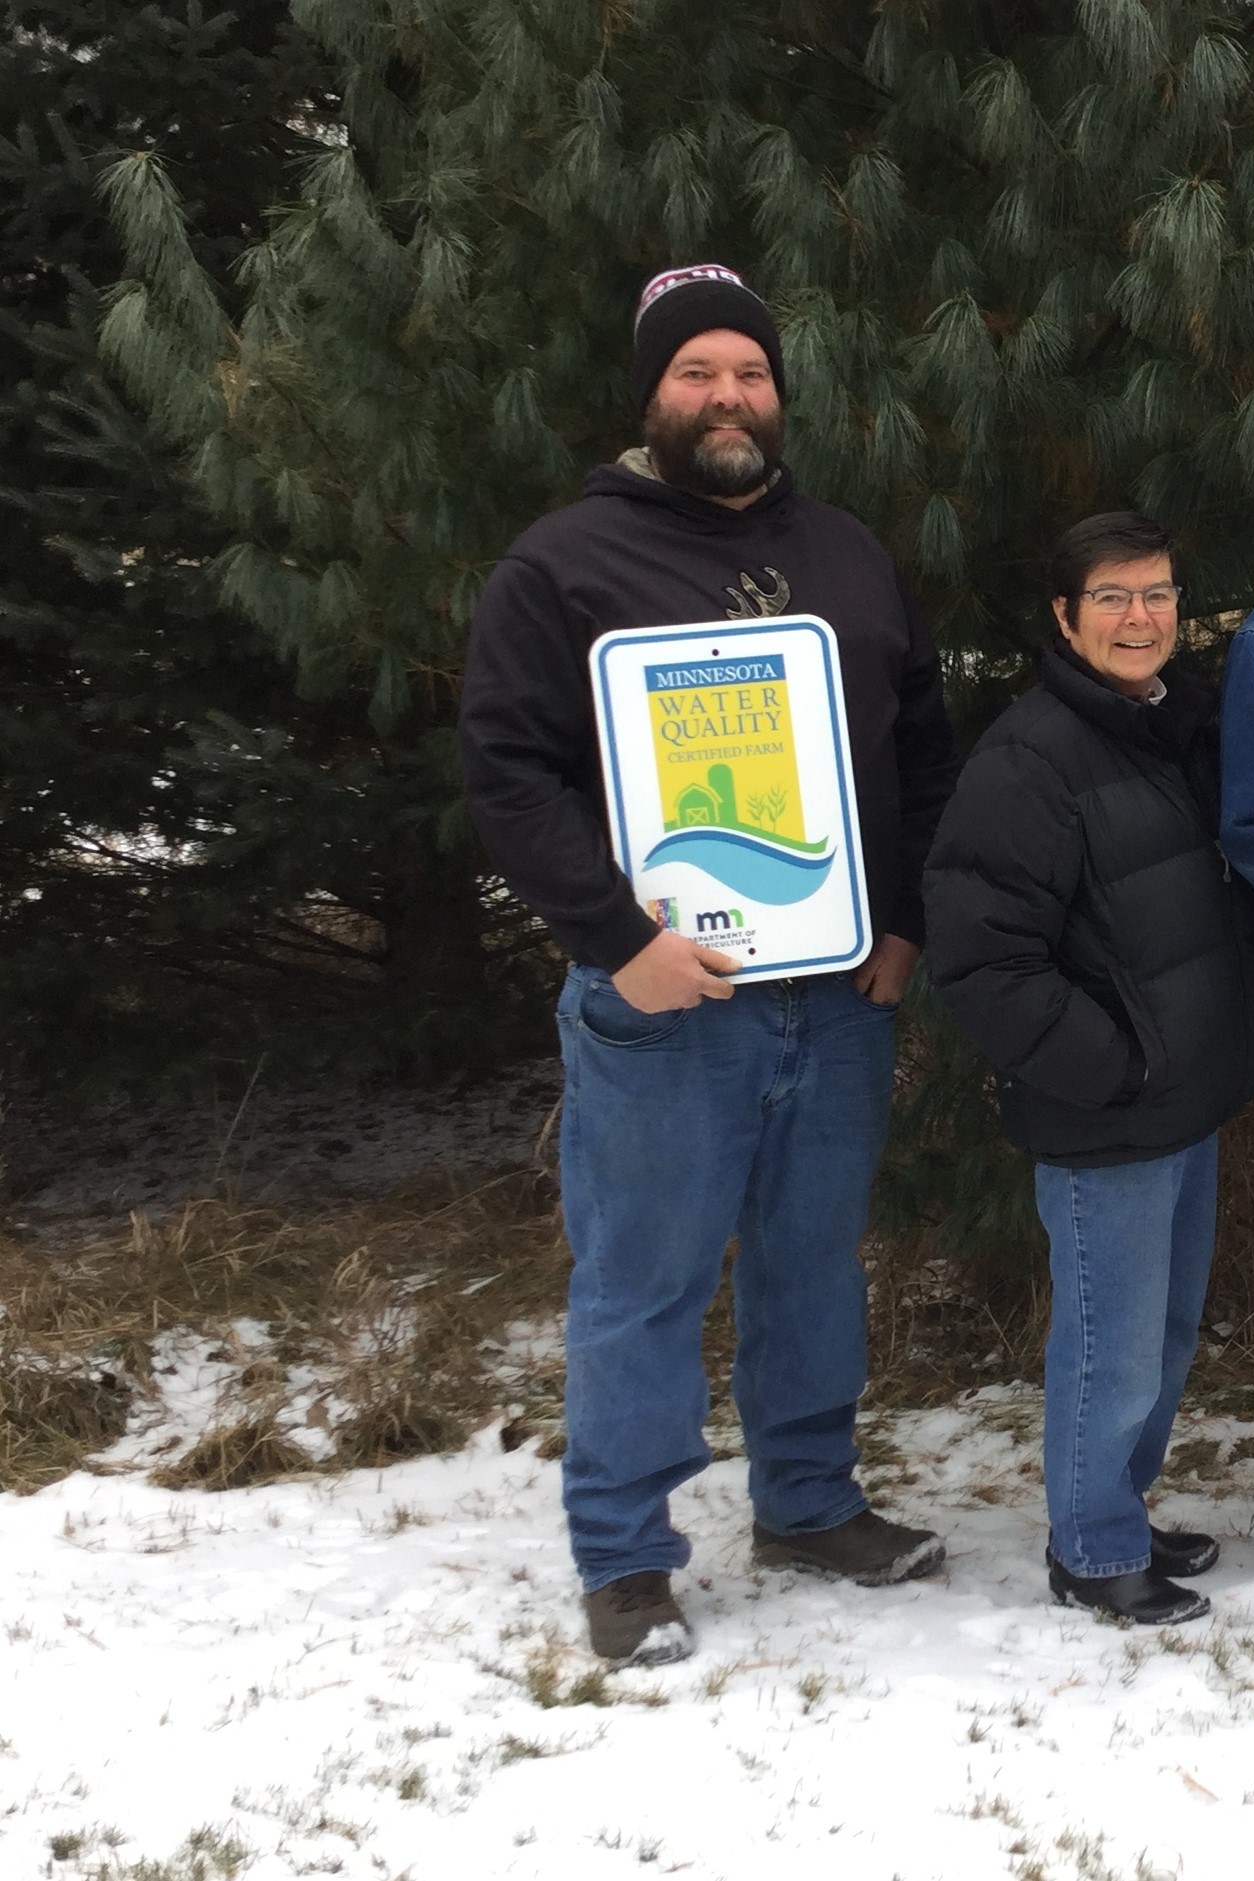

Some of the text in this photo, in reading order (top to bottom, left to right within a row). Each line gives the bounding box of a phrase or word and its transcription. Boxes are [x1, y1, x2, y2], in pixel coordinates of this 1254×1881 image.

[655, 663, 777, 688] MINNESOTA
[657, 687, 781, 717] WATER
[660, 711, 782, 747] QUALITY
[667, 742, 784, 764] CERTIFIED FARM
[688, 929, 757, 943] EPARTMENT OF
[697, 938, 753, 949] RICULTURE
